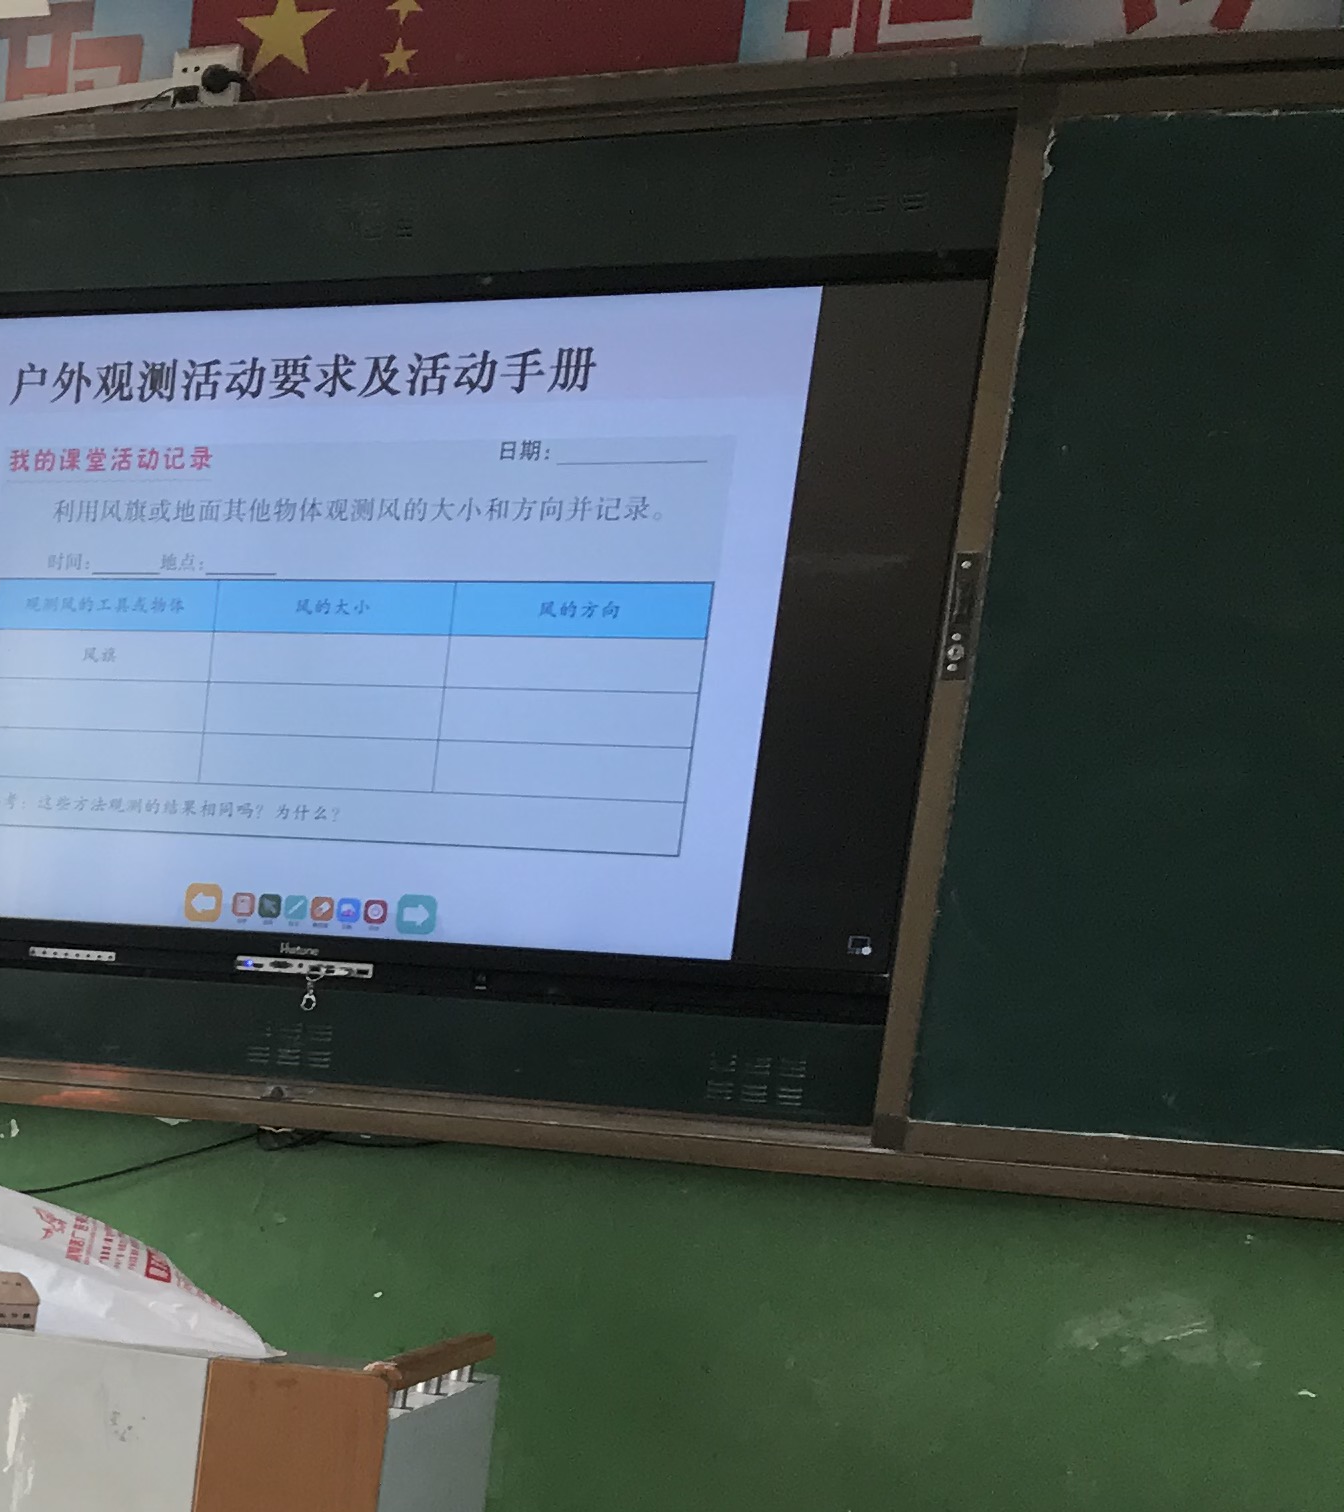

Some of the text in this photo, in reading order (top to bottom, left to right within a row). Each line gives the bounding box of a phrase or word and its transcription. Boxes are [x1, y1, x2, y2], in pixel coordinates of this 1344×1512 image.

[10, 346, 597, 405] 户外观测活动要求及活动手册
[9, 446, 213, 472] 我的课堂活动记录
[52, 495, 663, 524] 利用风旗或地面其他物体观测风的大小和方向并记录。
[295, 598, 372, 616] 风的大小
[537, 600, 621, 619] 风的方向
